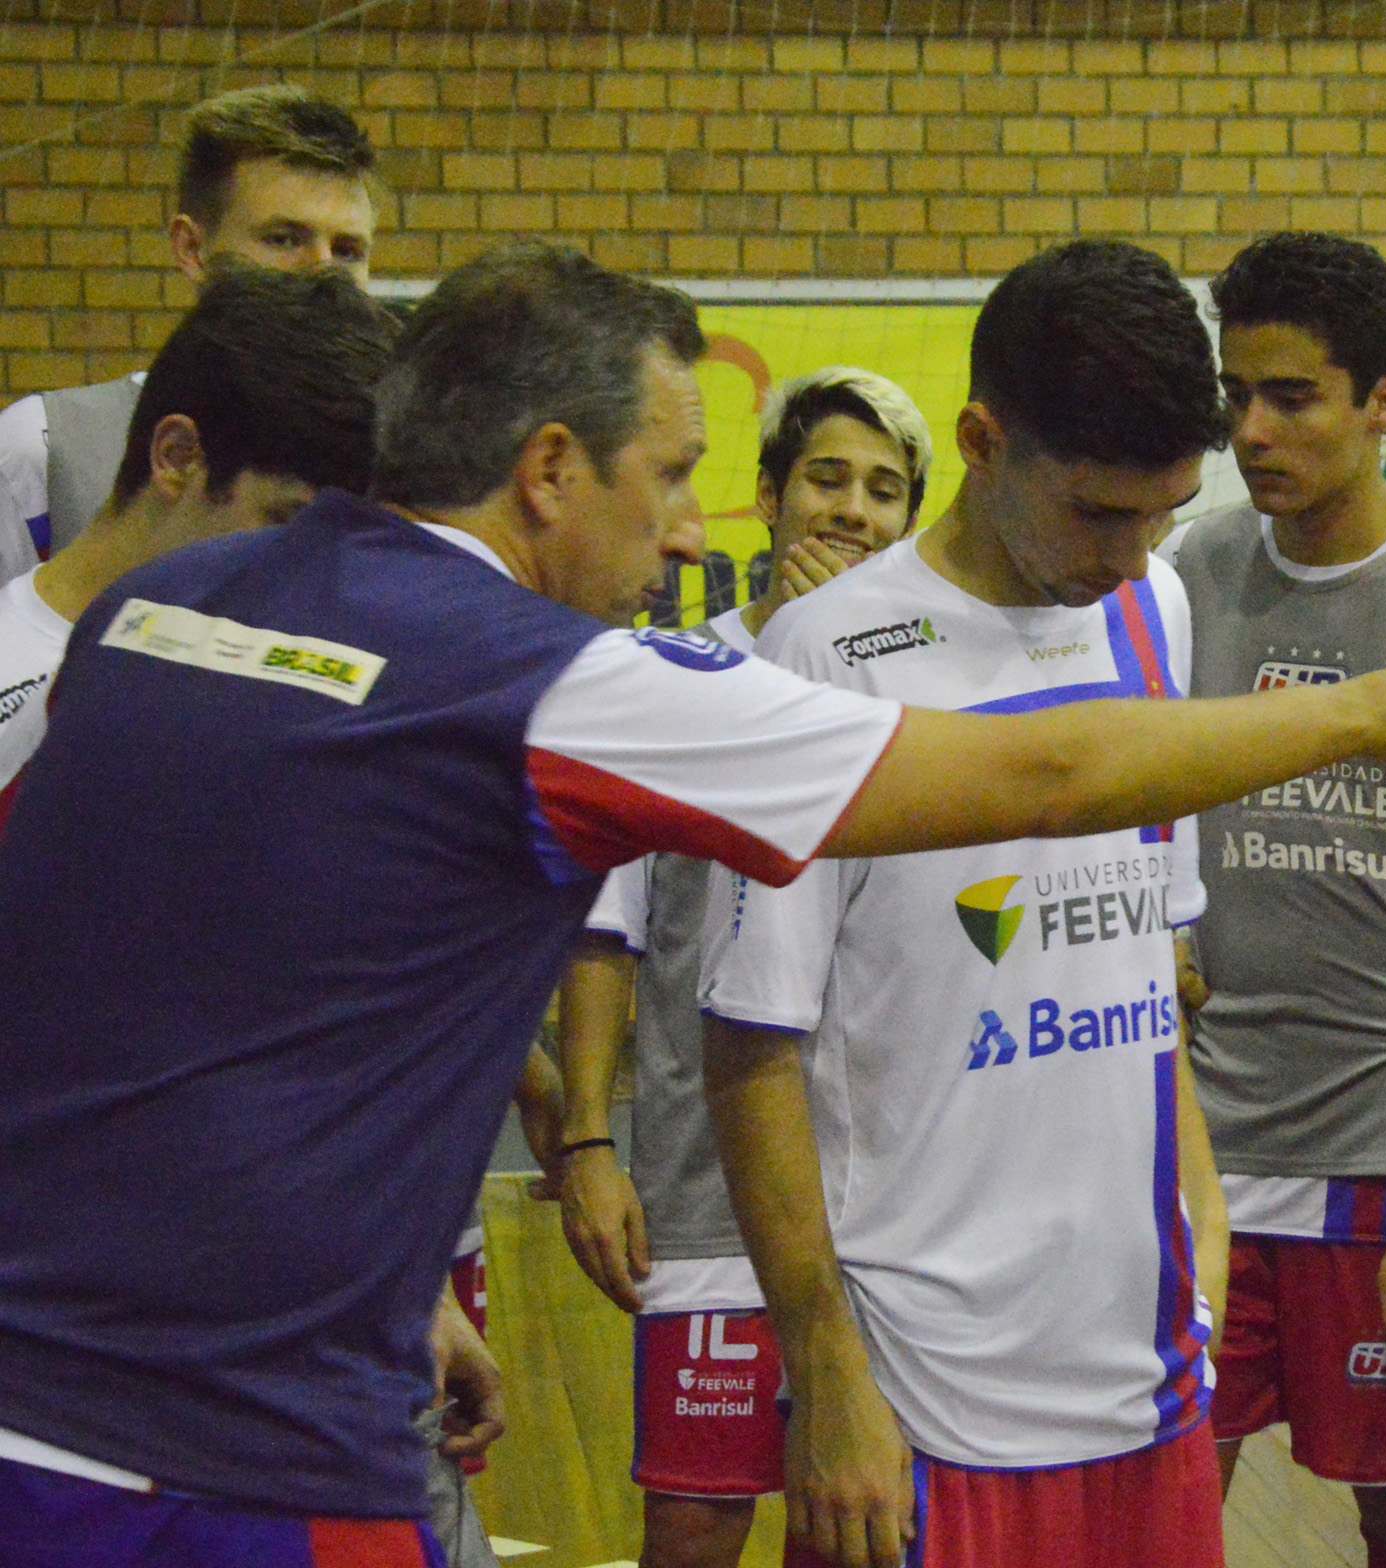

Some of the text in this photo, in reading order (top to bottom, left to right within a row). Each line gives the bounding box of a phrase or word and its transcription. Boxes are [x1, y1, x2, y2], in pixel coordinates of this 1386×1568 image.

[834, 619, 932, 666] Formax
[698, 1378, 756, 1391] FEEVALE
[675, 1396, 754, 1417] Banrisul
